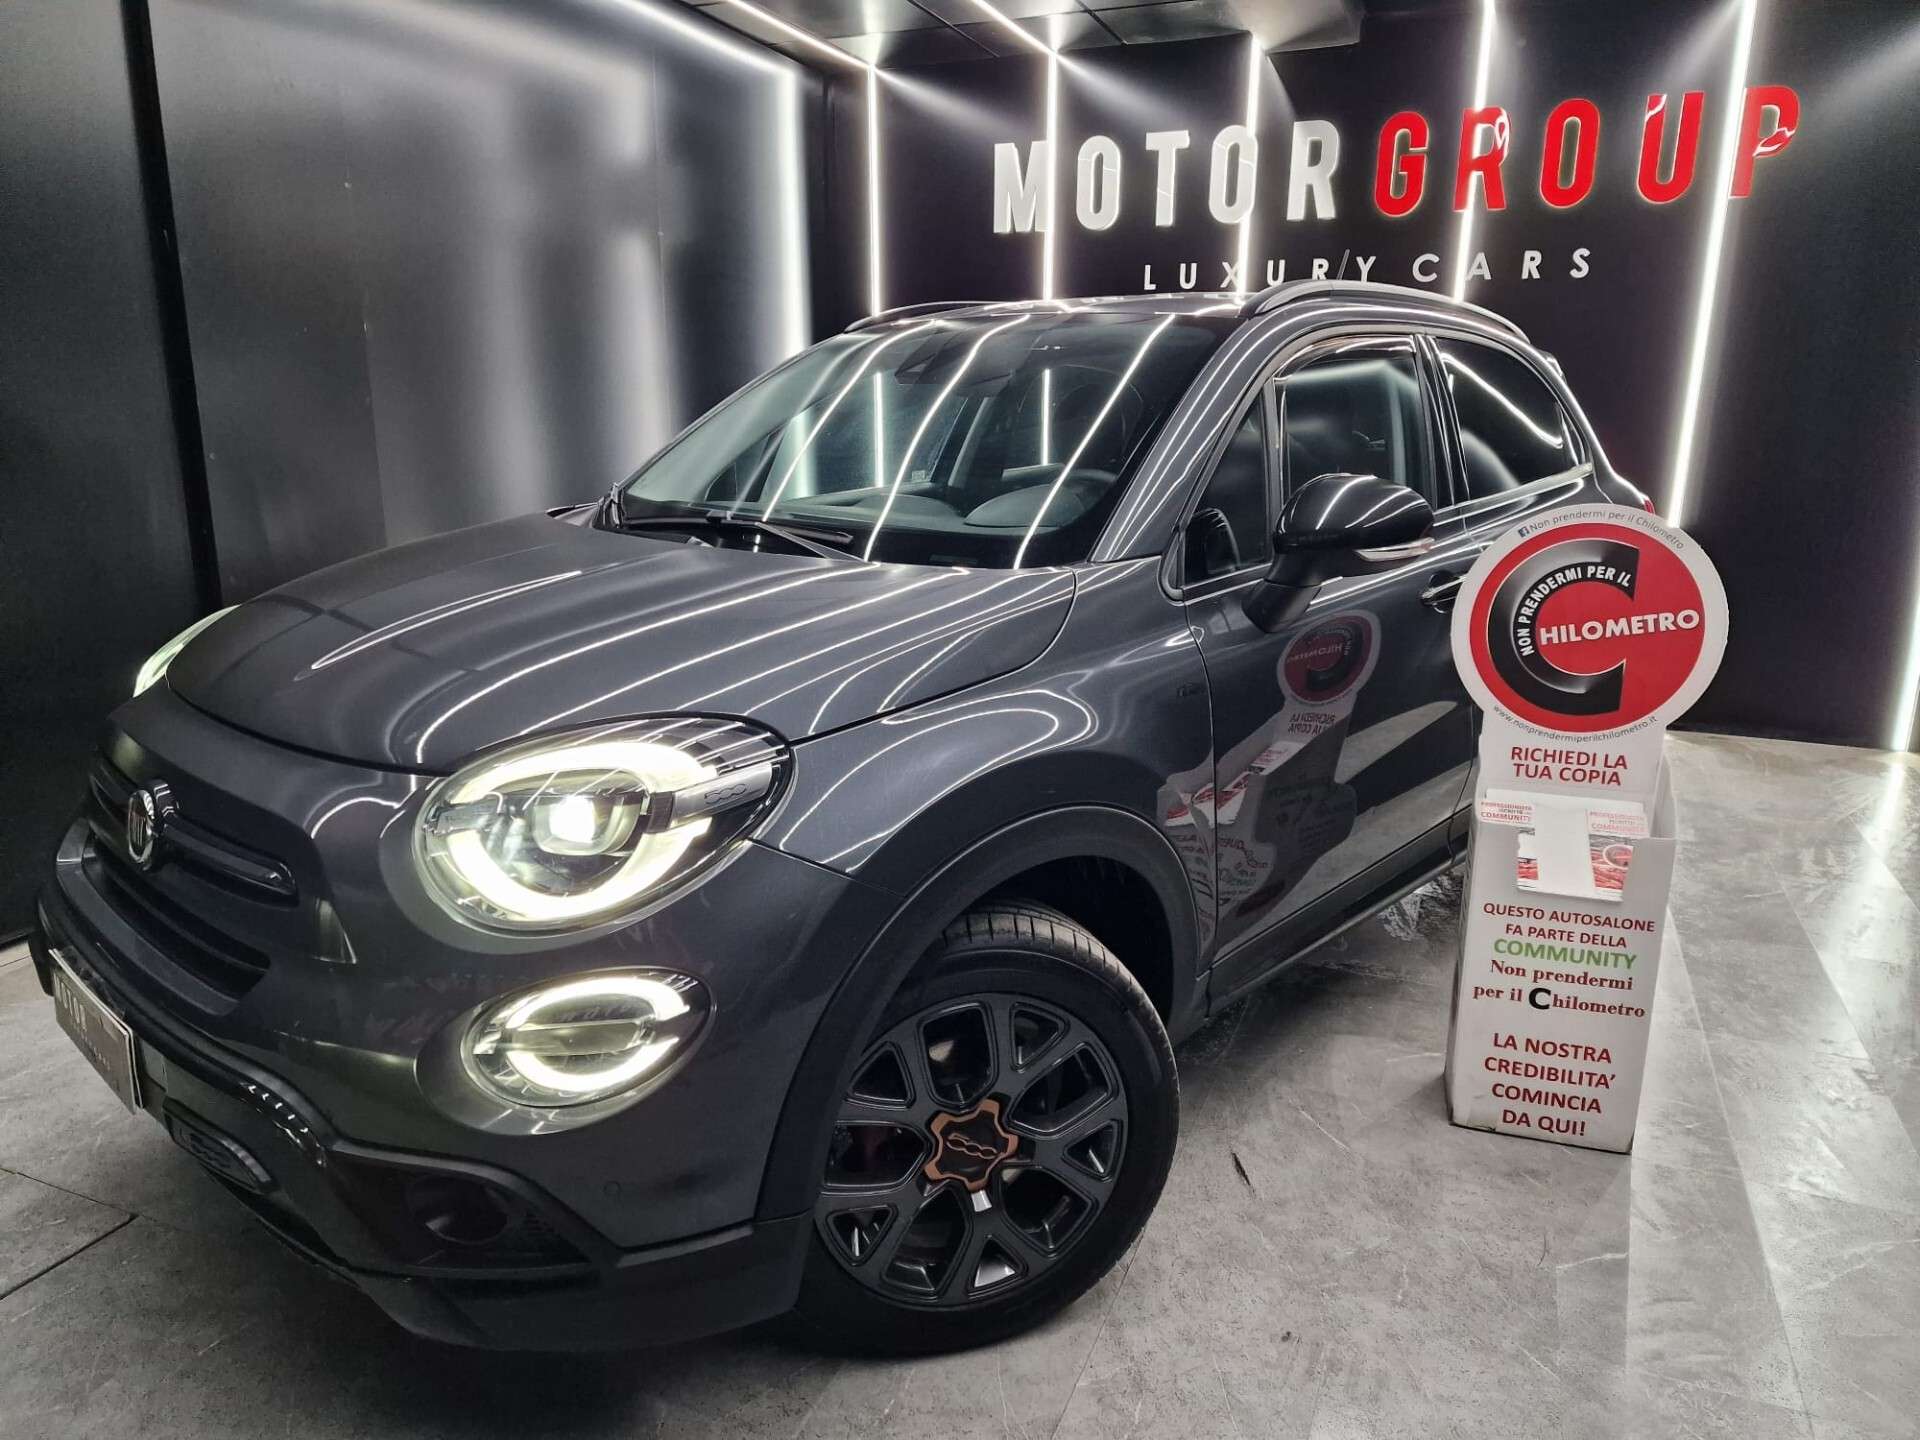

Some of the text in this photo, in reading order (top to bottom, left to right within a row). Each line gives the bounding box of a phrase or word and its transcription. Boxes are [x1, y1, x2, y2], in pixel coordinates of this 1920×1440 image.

[1143, 247, 1592, 291] LUXURY CARS
[1529, 518, 1551, 532] Non
[1553, 510, 1606, 526] prendermi
[1608, 511, 1626, 522] per
[1627, 512, 1635, 522] il
[1636, 516, 1685, 550] Chilometro
[1517, 565, 1633, 657] NON PRENDERMI PER IL
[1511, 746, 1629, 770] RICHIEDI LA
[1512, 762, 1622, 787] TUA COPIA
[1483, 902, 1656, 933] QUESTO AUTOSALONE
[1505, 923, 1628, 949] FA PARTE DELLA
[1493, 938, 1637, 970] COMMUNITY
[1490, 959, 1634, 991] Non prendermi
[1472, 985, 1646, 1018] per il Chilometro
[1493, 1032, 1613, 1064] LA NOSTRA
[1491, 1083, 1602, 1114] COMINCIA
[1502, 1109, 1587, 1137] DA QUI!
